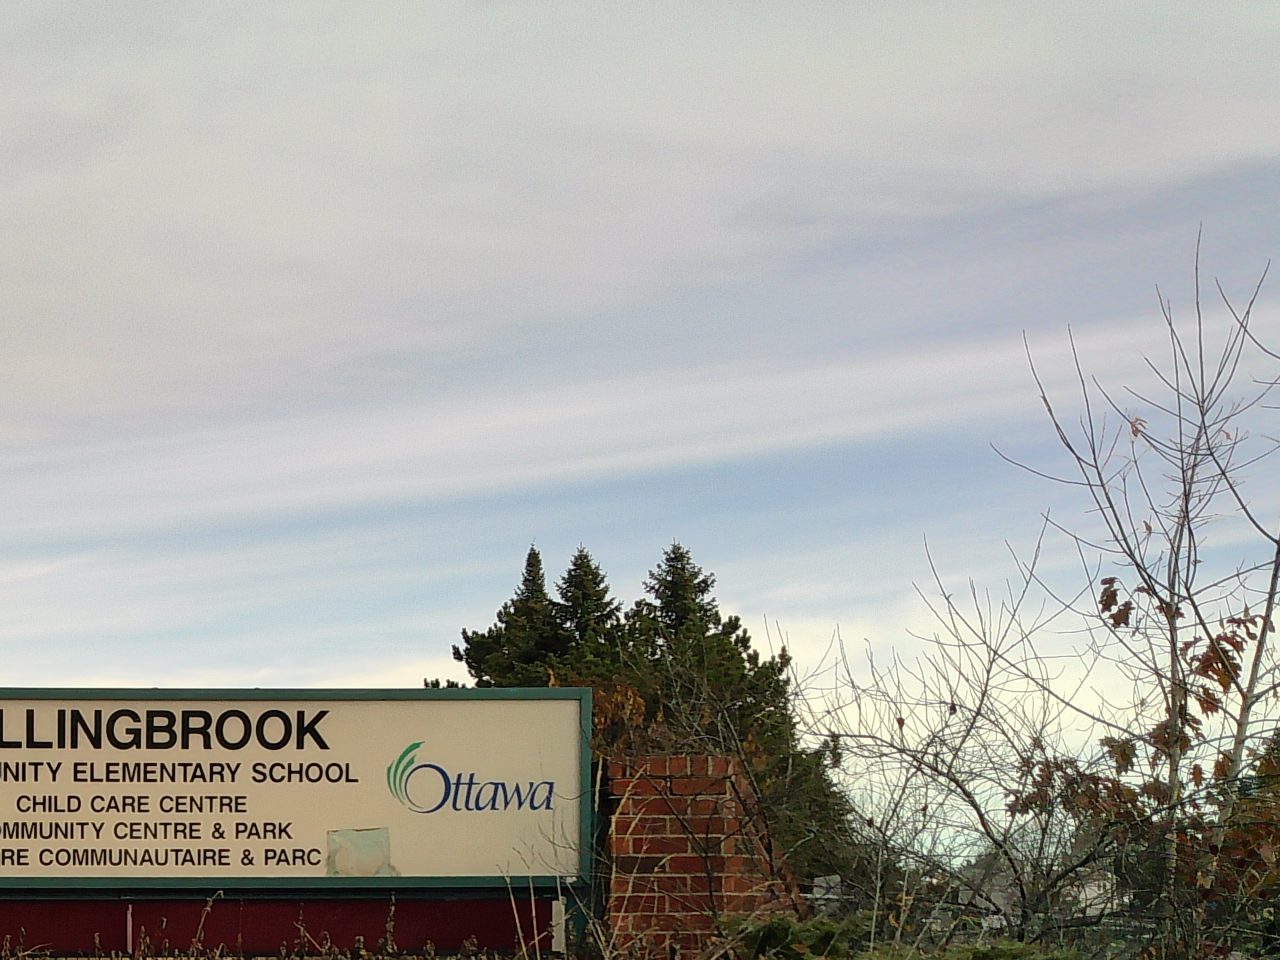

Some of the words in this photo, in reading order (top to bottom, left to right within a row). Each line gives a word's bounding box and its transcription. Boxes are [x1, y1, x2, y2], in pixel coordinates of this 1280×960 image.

[73, 761, 242, 783] ELEMENTARY
[251, 762, 359, 784] SCHOOL
[403, 763, 555, 814] Ottawa
[16, 795, 82, 813] CHILD
[90, 795, 150, 813] CARE
[159, 795, 248, 814] CENTRE
[113, 821, 202, 840] CENTRE
[211, 822, 226, 840] &
[235, 822, 293, 840] PARK
[38, 848, 231, 867] COMMUNAUTAIRE
[240, 848, 255, 867] &
[264, 848, 322, 866] PARC
